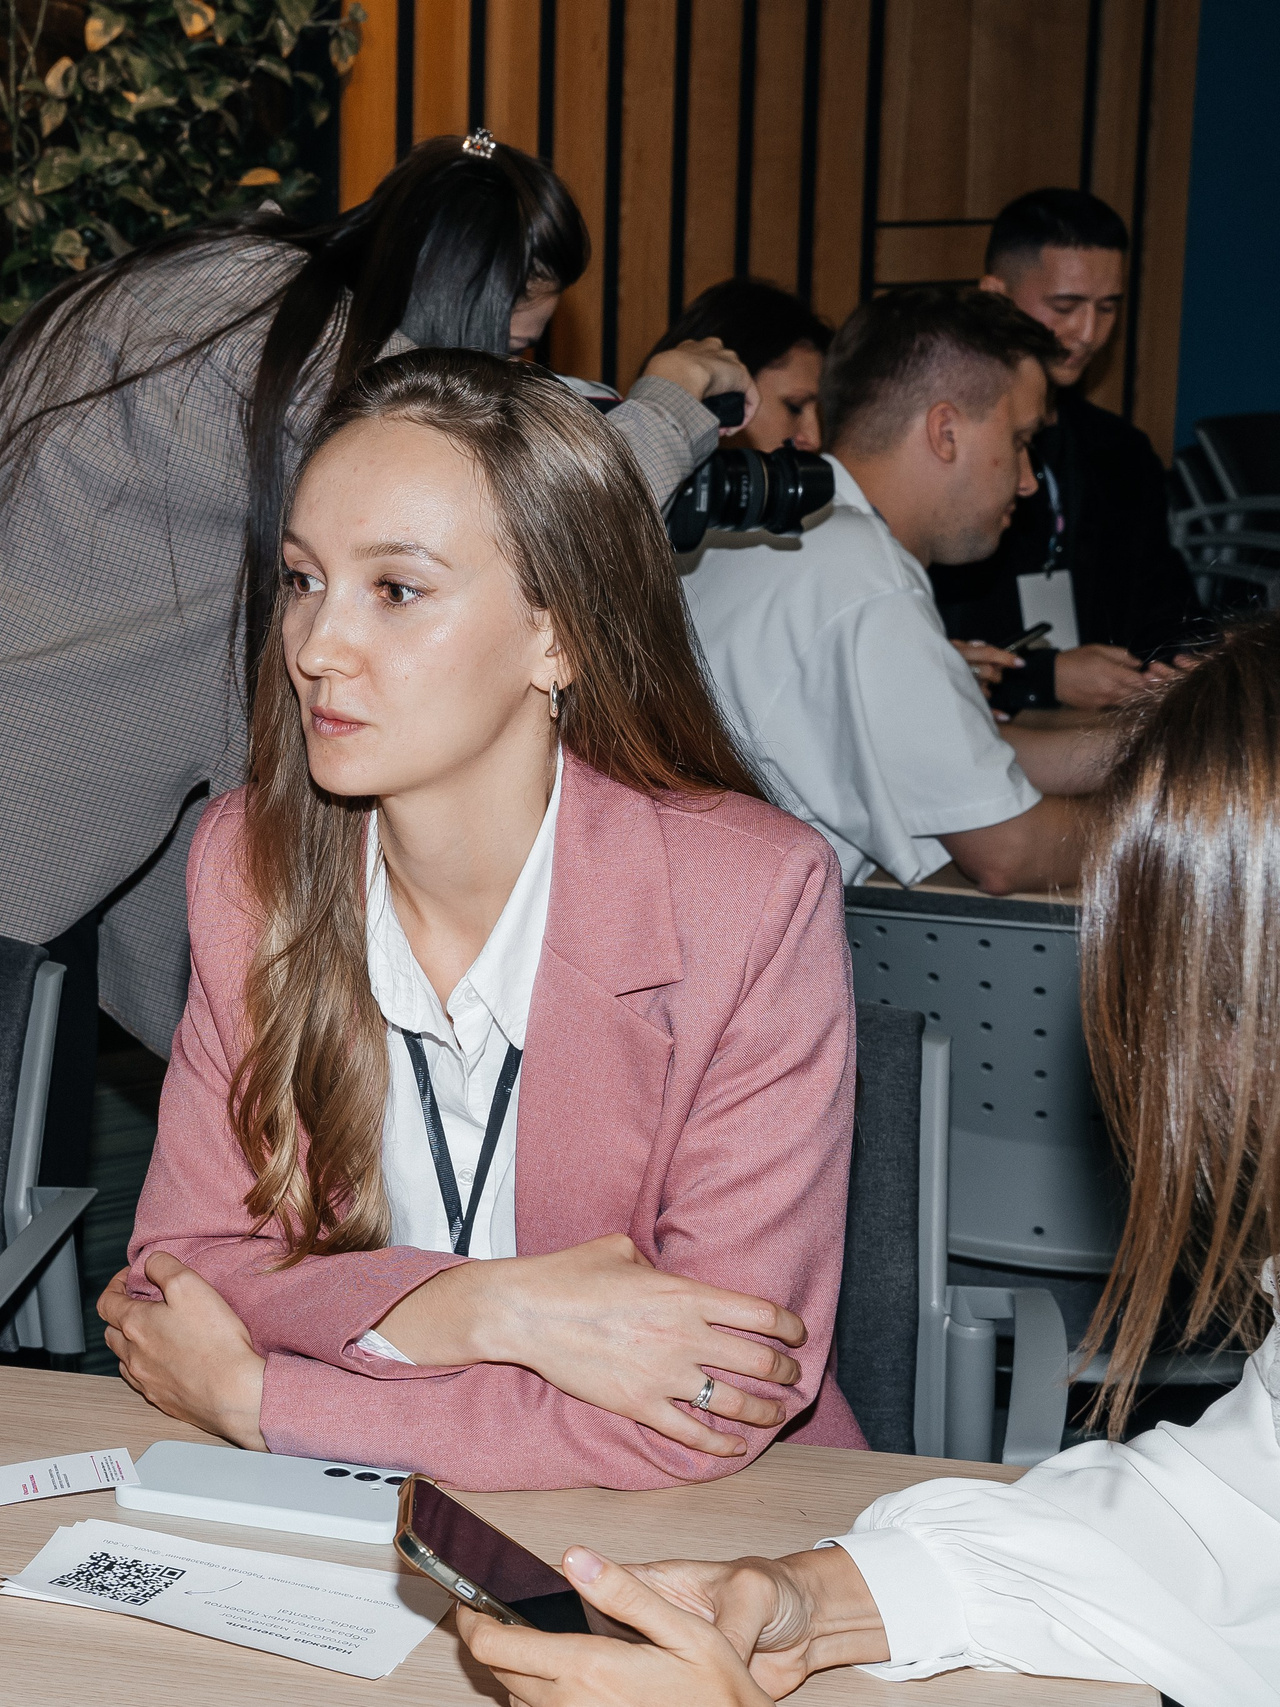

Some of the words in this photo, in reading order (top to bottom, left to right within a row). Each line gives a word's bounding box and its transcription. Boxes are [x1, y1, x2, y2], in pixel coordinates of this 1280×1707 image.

[103, 1538, 161, 1556] @work_in_edu
[268, 1577, 320, 1591] вакансиями
[328, 1590, 354, 1599] канал
[364, 1597, 400, 1609] Соцсети
[204, 1600, 260, 1617] проектов
[219, 1612, 289, 1632] маркетолог
[262, 1613, 368, 1642] образовательных
[277, 1608, 377, 1635] @nadia_rozental
[225, 1621, 291, 1641] Розенталь
[292, 1627, 360, 1649] Методолог,
[294, 1638, 353, 1655] Надежда
